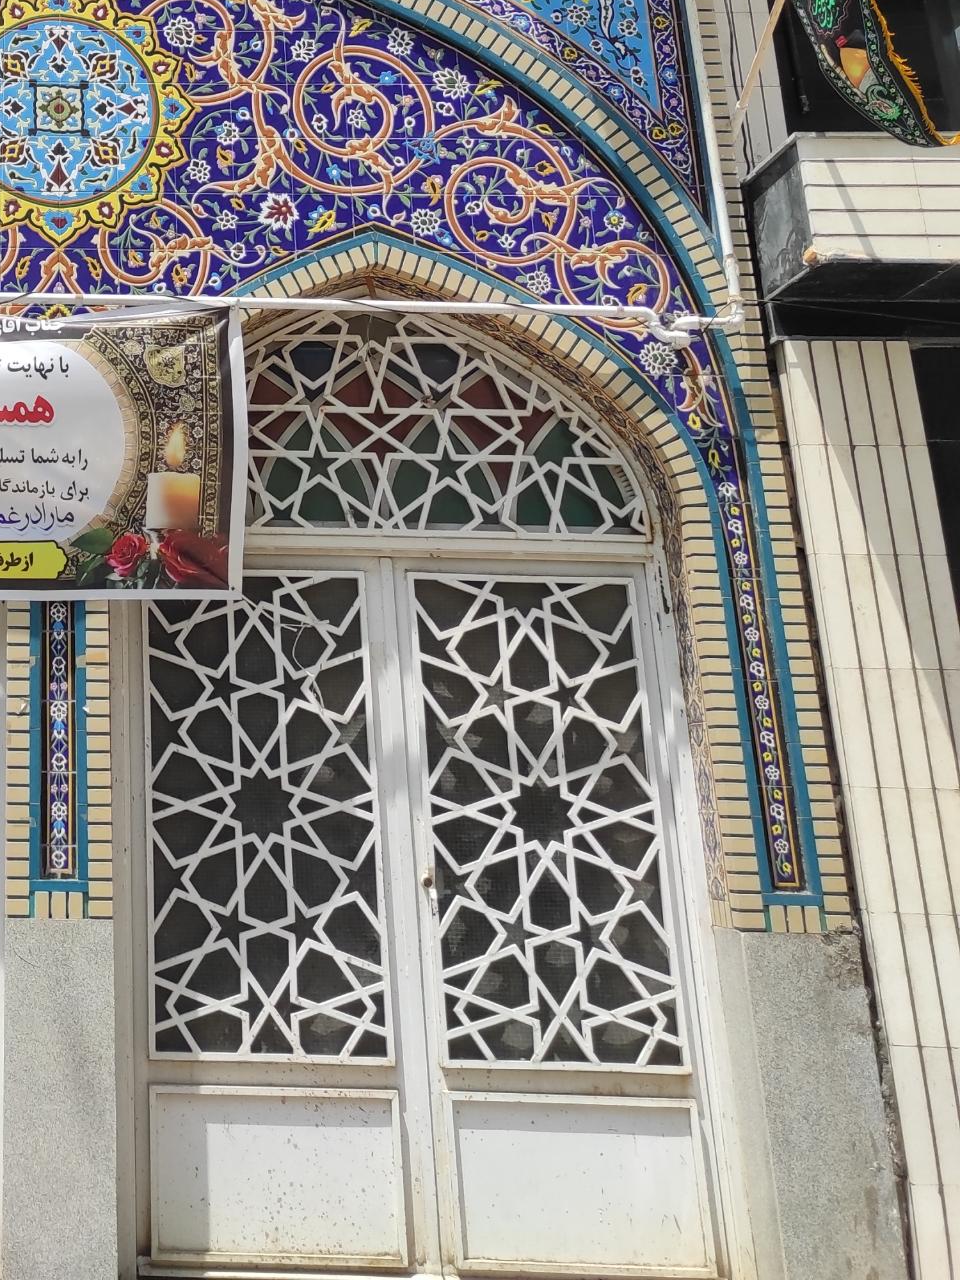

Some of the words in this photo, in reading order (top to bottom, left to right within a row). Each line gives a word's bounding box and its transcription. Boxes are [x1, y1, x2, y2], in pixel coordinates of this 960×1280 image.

[7, 356, 56, 380] نهایت
[59, 356, 71, 378] با
[31, 443, 59, 464] شما
[61, 451, 77, 466] به
[78, 449, 88, 471] را
[60, 480, 89, 503] برای
[54, 505, 75, 525] ما
